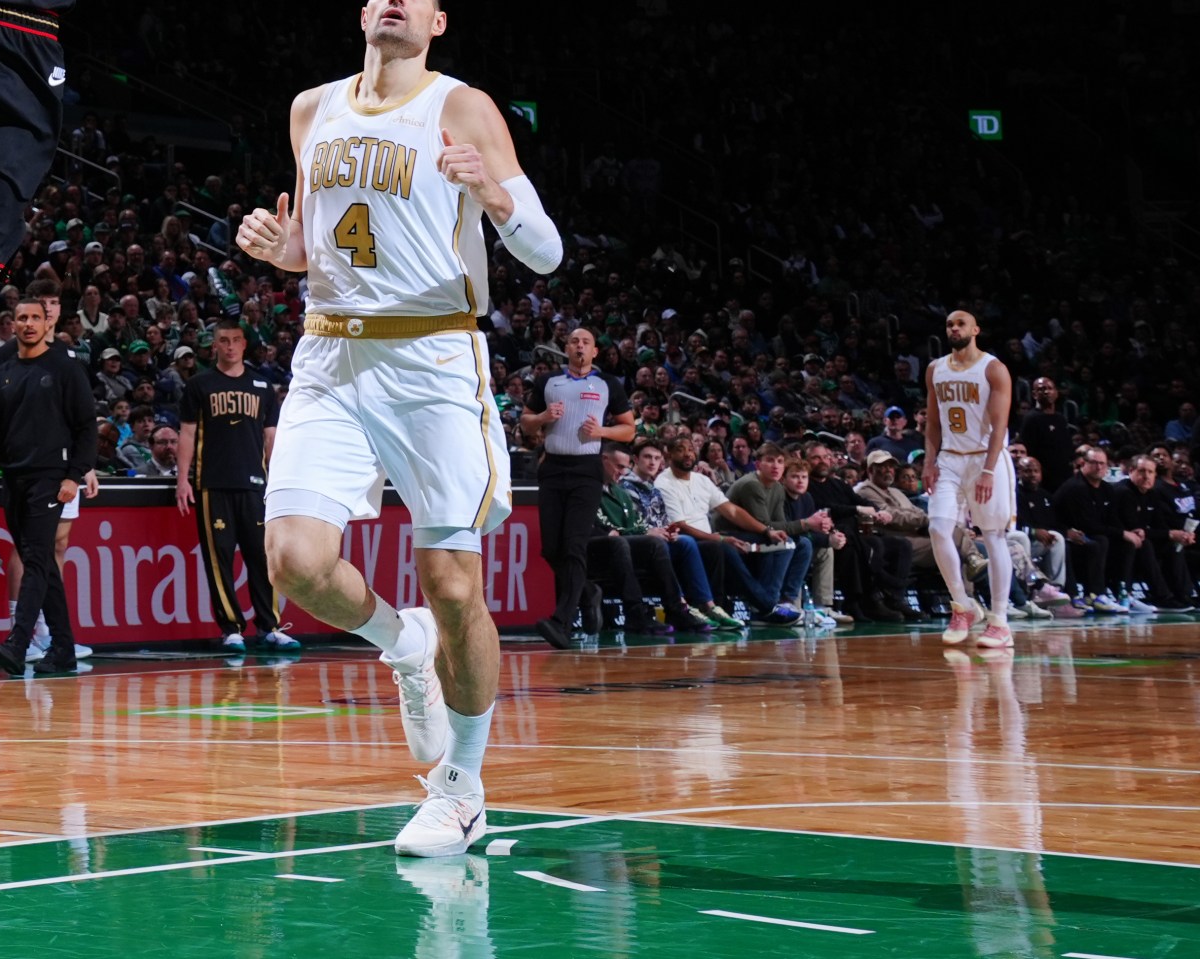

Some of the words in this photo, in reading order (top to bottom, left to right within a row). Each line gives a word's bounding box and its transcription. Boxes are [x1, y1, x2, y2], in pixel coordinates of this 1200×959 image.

[392, 111, 425, 128] Amica
[972, 115, 999, 134] TD
[310, 137, 417, 200] BOSTON
[333, 203, 377, 267] 4
[209, 390, 260, 419] BOSTON
[947, 406, 968, 434] 9
[396, 522, 528, 612] BER
